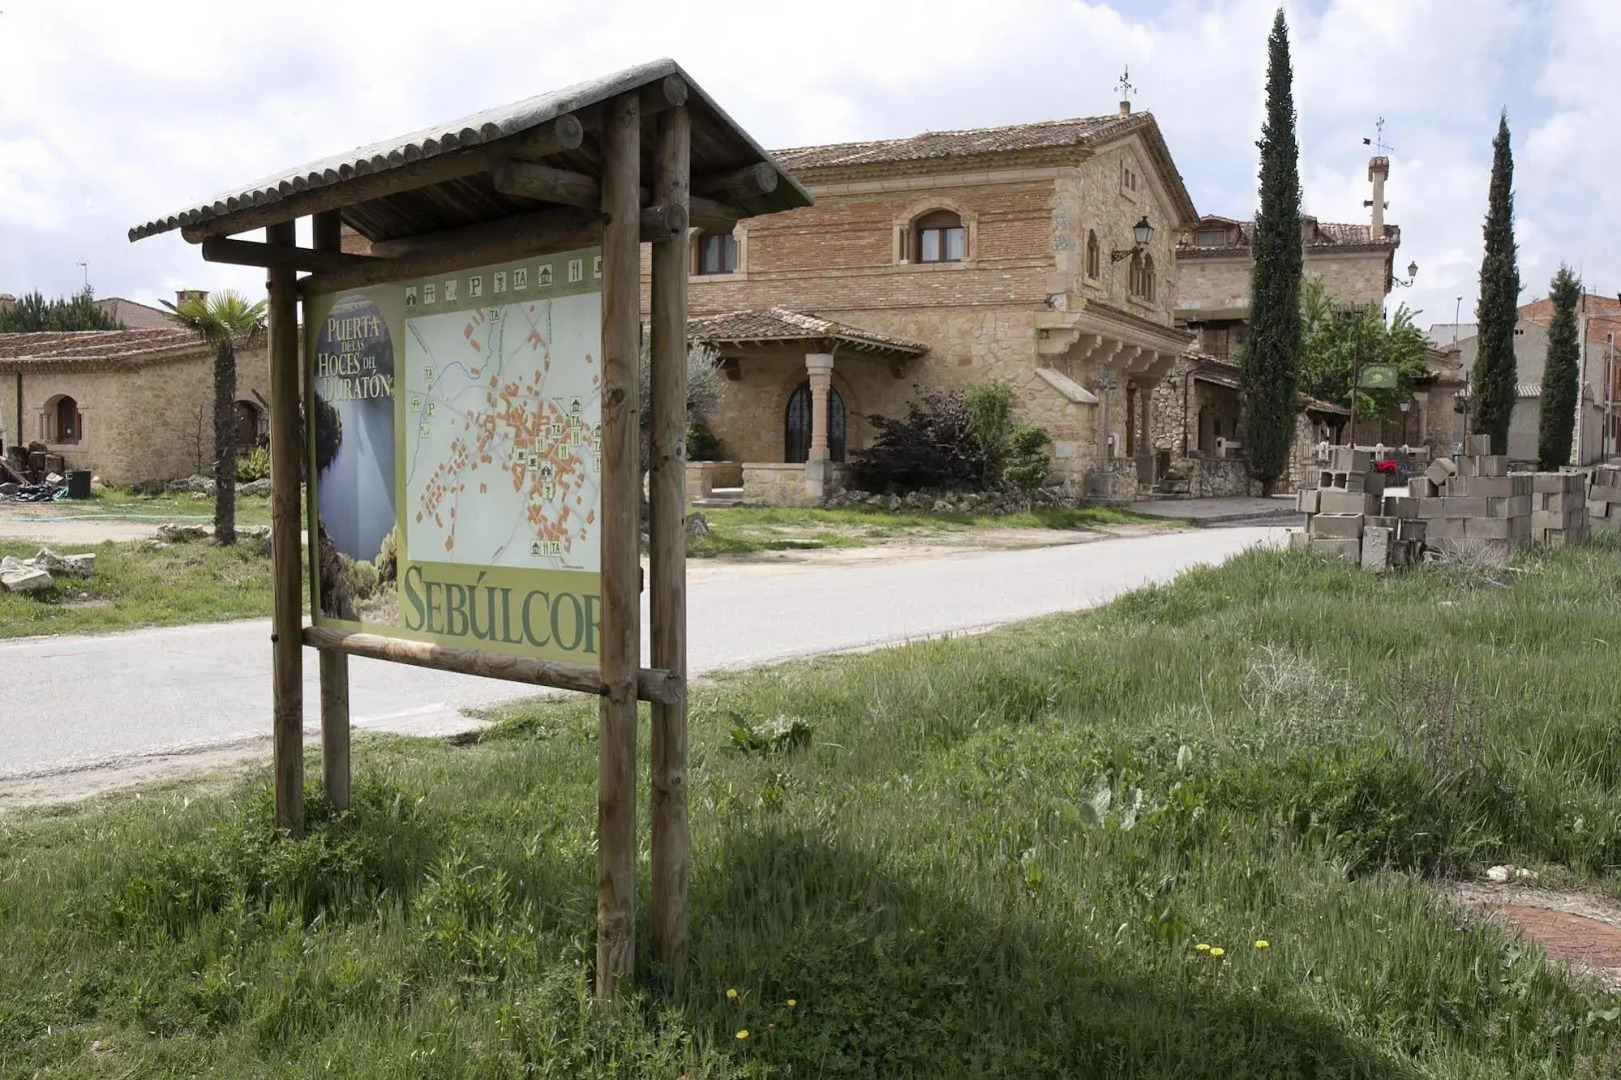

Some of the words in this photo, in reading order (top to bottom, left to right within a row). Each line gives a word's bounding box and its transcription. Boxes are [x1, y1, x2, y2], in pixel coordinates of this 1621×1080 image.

[515, 272, 526, 285] TA
[471, 278, 480, 295] P
[491, 310, 498, 319] TA
[328, 315, 380, 343] PUERTA
[318, 353, 360, 377] HOCES
[363, 356, 377, 370] DEL
[425, 369, 432, 377] TA
[323, 369, 391, 401] DURATÓN
[571, 416, 580, 425] TA
[552, 425, 561, 433] TA
[552, 543, 560, 551] TA
